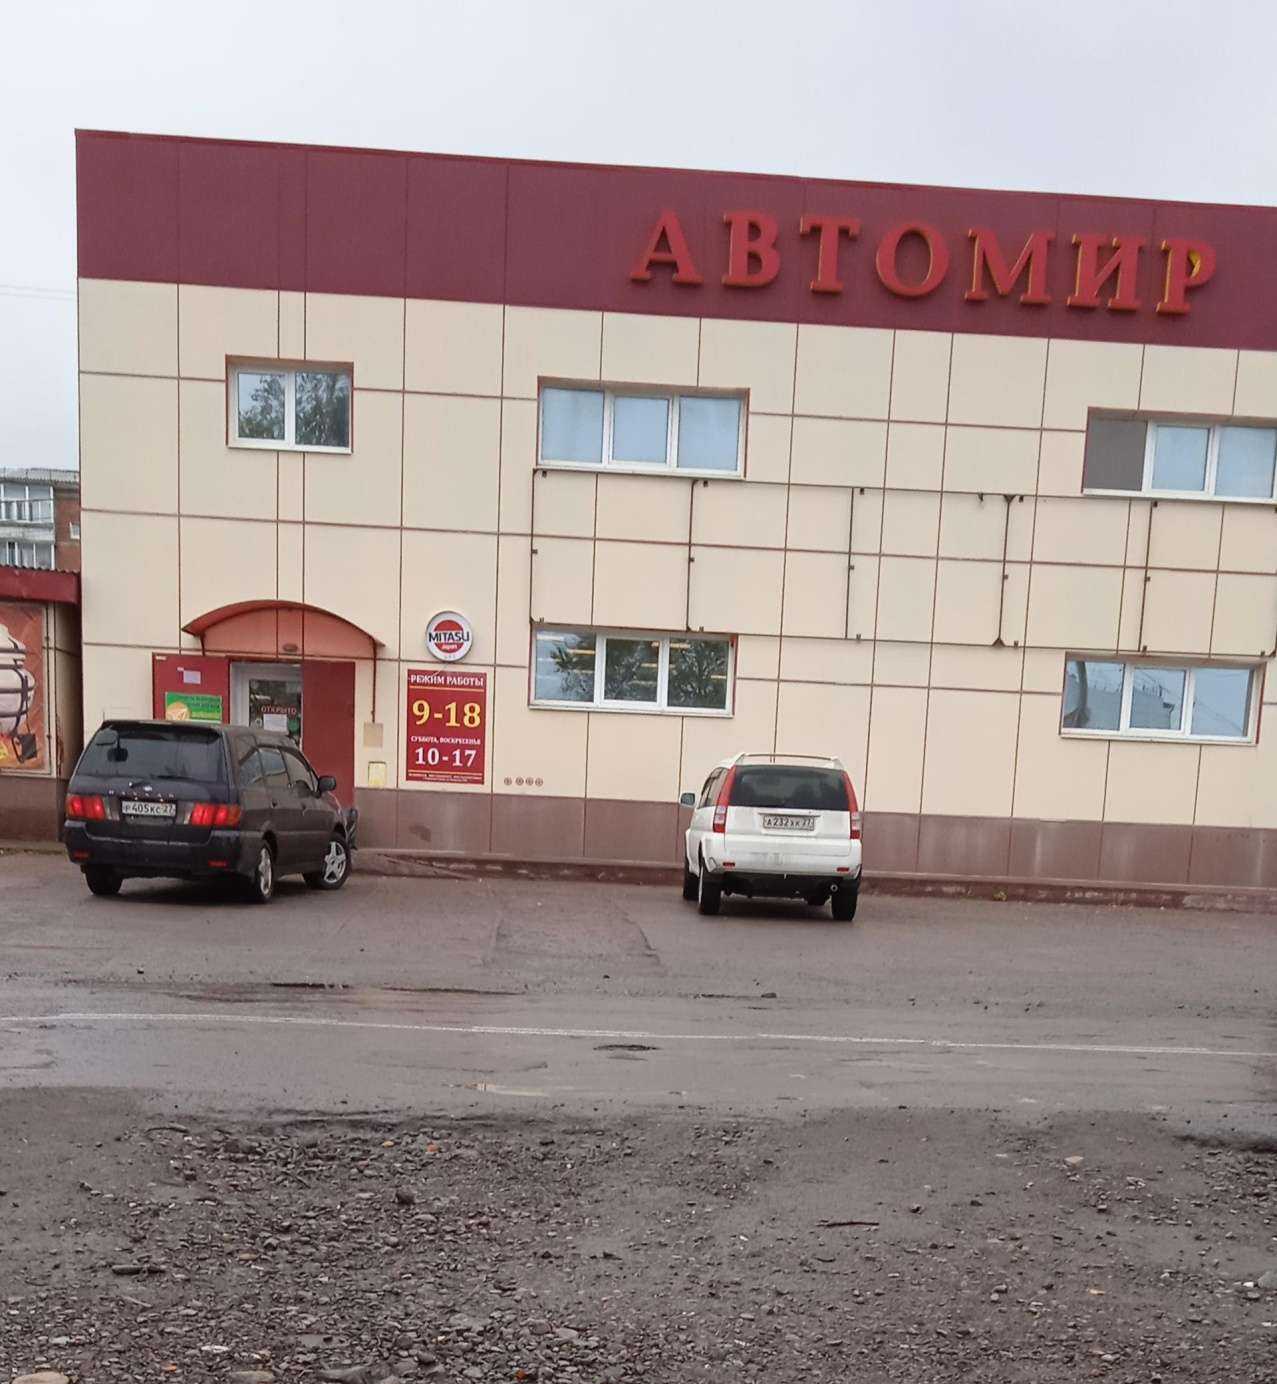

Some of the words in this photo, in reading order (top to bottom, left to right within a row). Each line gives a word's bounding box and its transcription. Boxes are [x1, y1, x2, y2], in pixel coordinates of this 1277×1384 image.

[630, 208, 1217, 315] АВТОМИР
[428, 631, 470, 642] MITASU
[410, 674, 444, 684] РЕЖИМ
[447, 676, 484, 687] РАБОТЫ
[260, 704, 297, 715] ОТКРЫТО
[412, 699, 481, 728] 9-18
[415, 747, 477, 768] 10-17
